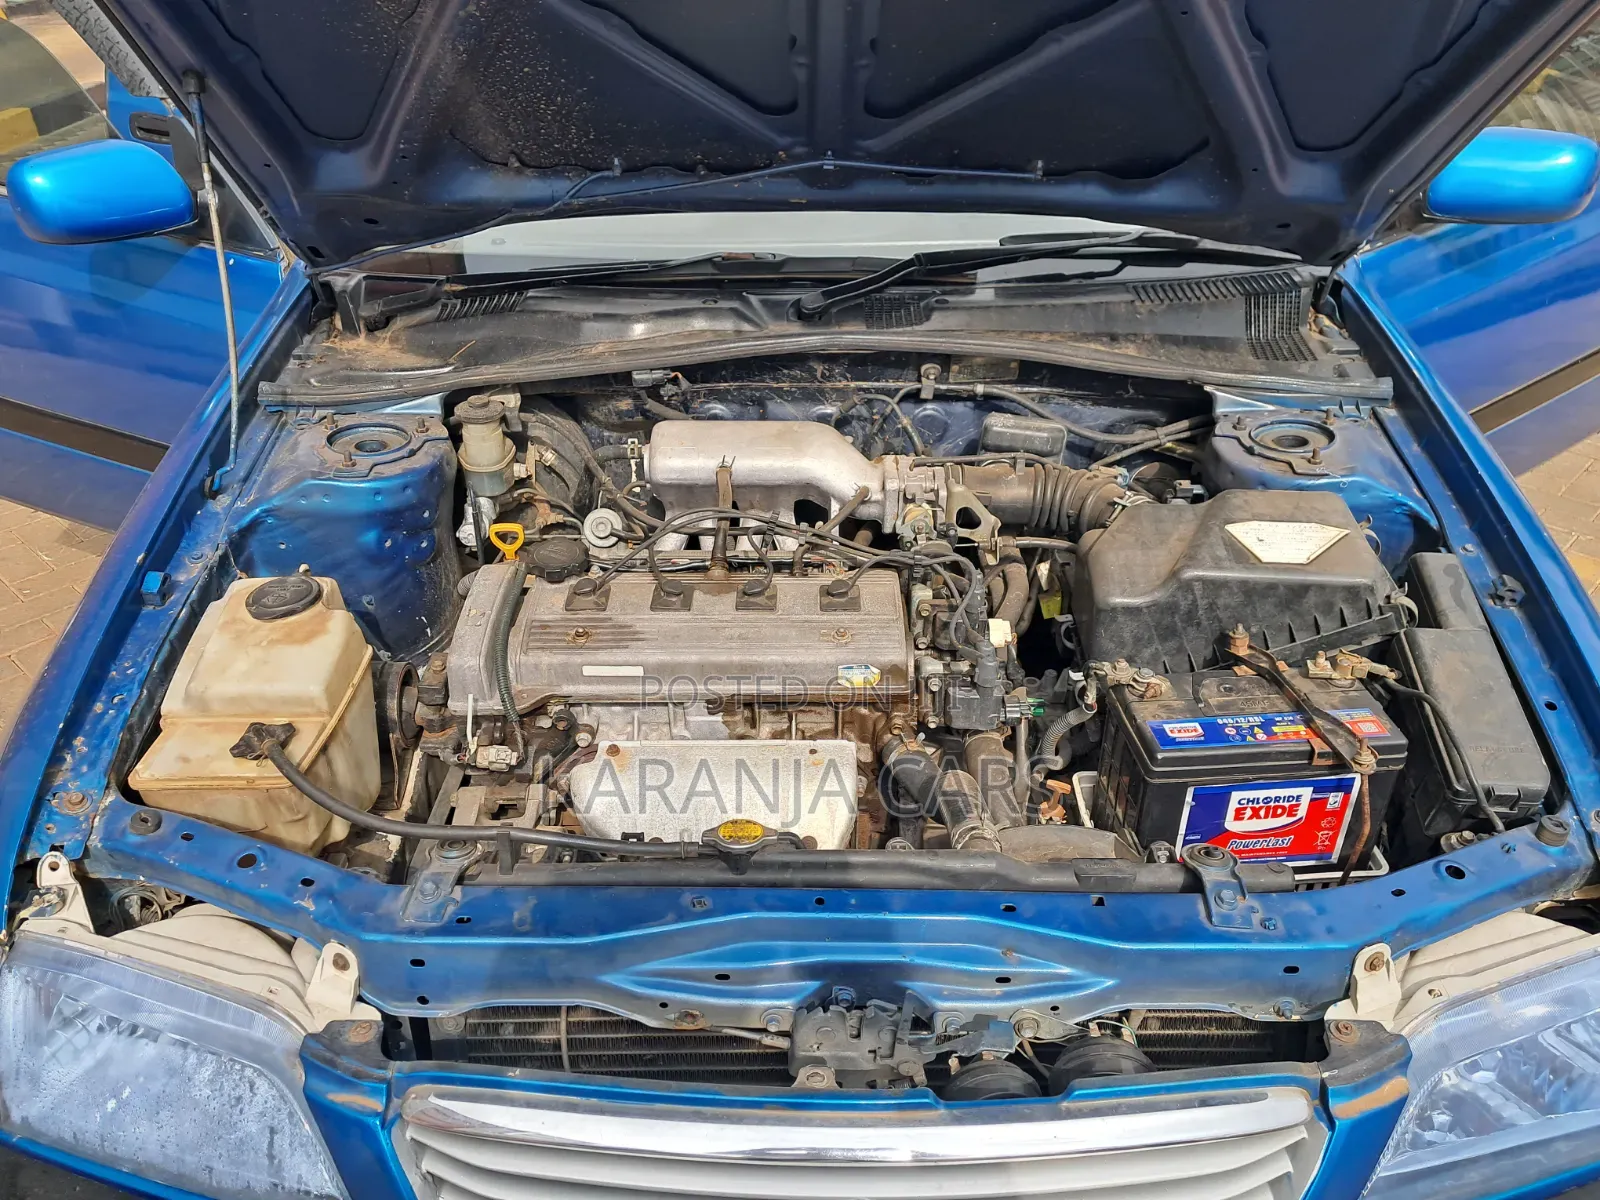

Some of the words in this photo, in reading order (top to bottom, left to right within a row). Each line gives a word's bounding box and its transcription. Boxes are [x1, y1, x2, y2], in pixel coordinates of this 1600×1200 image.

[1237, 794, 1303, 806] CHLORIDE
[1233, 803, 1302, 821] EXIDE
[1226, 836, 1294, 850] PowerLast
